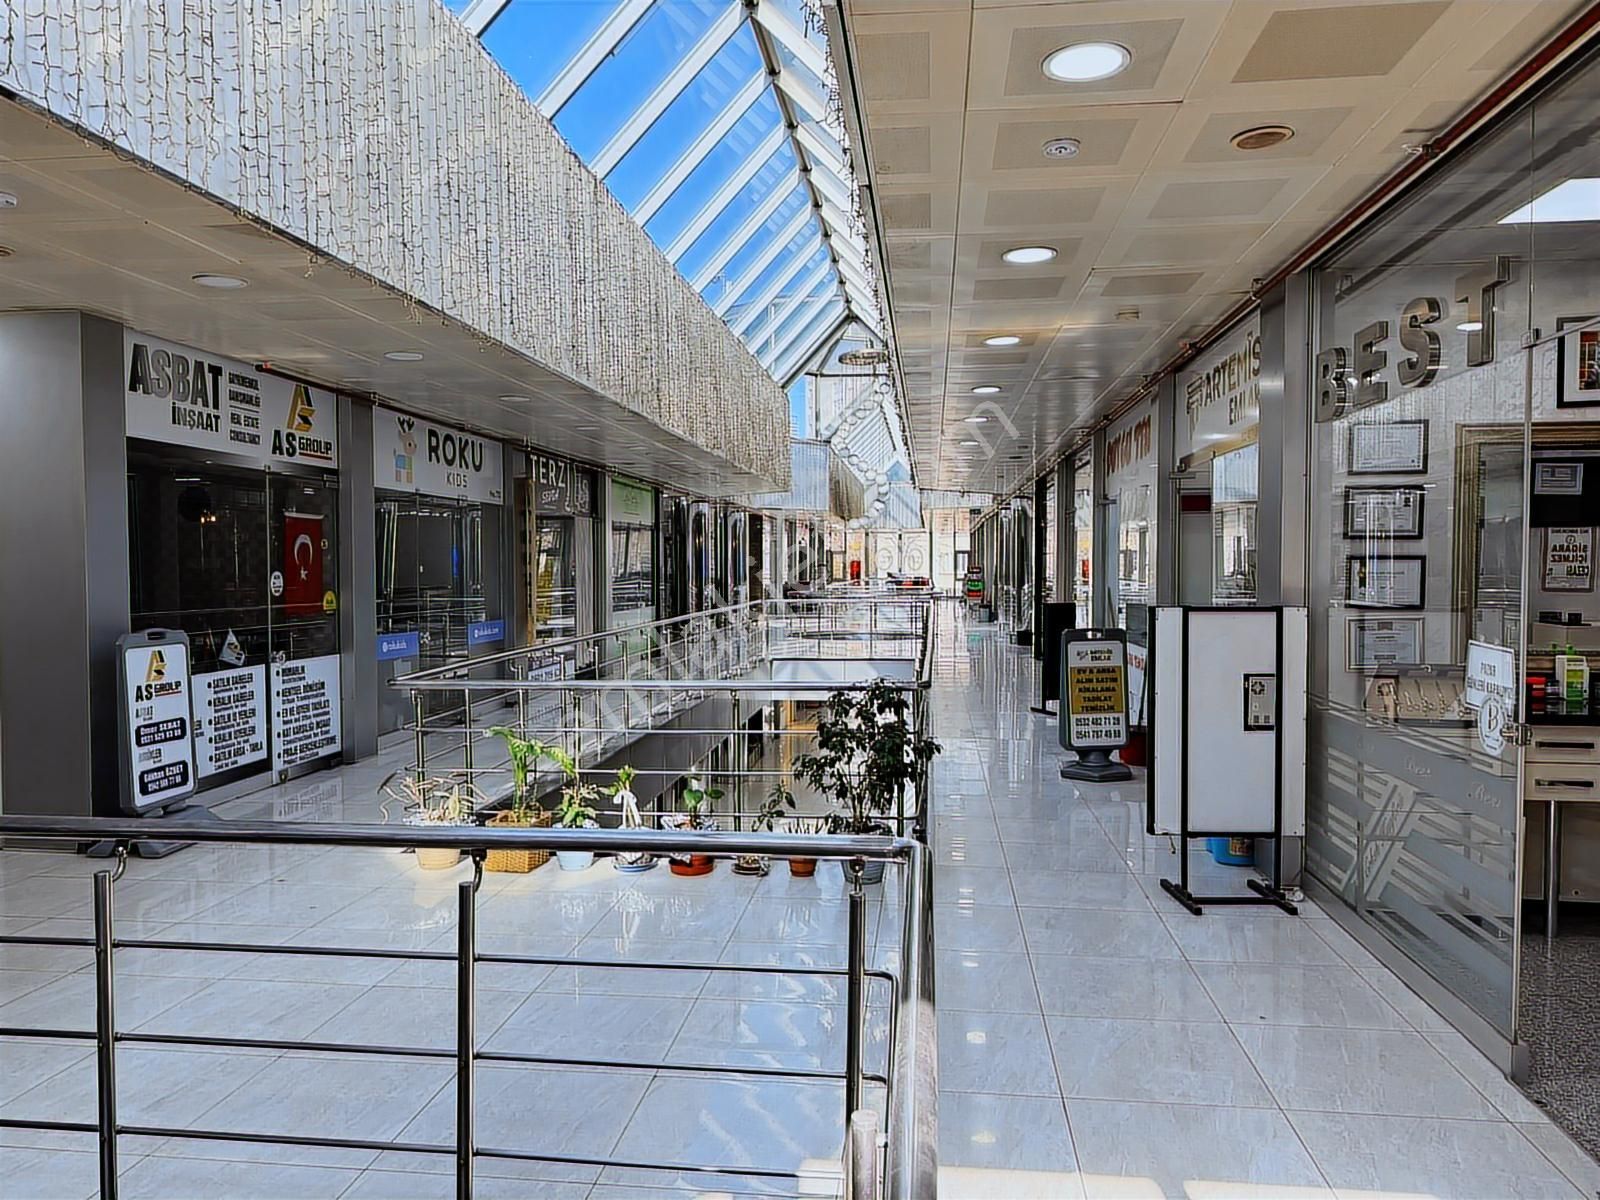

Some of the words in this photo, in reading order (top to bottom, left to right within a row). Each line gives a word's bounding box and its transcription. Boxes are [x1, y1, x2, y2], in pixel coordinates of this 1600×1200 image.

[1315, 255, 1511, 424] BEST
[128, 343, 223, 410] ASBAT
[1203, 331, 1261, 407] ARTEMİS
[172, 402, 221, 433] İNŞAAT
[271, 429, 297, 458] AS
[298, 436, 333, 456] GROUP
[427, 428, 483, 473] ROKU
[446, 471, 468, 488] KIDS
[135, 683, 153, 702] AS
[154, 681, 182, 693] GROUP
